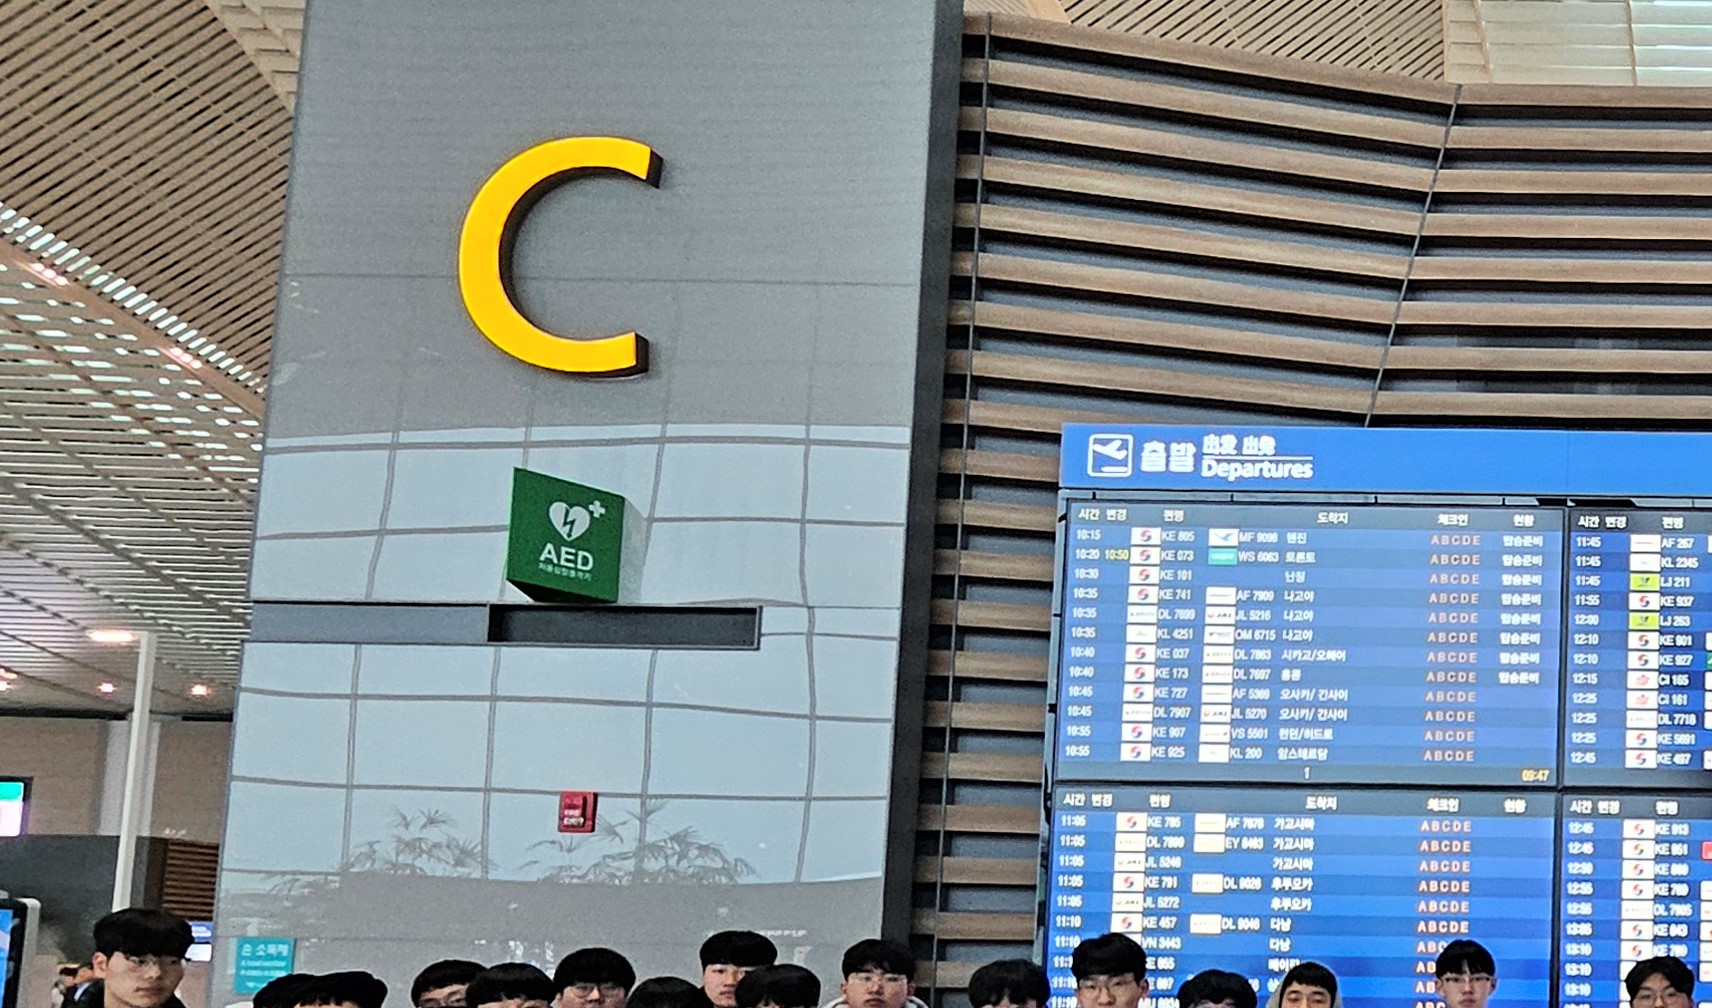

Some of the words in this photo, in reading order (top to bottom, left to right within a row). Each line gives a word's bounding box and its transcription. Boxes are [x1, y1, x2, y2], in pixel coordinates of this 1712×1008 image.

[459, 136, 661, 378] C
[1141, 441, 1196, 473] 출발
[1201, 460, 1313, 481] Departures
[1079, 509, 1099, 521] 시간
[1106, 509, 1127, 521] 변경
[1163, 510, 1184, 522] 편명
[1317, 512, 1348, 524] 도착지
[1437, 514, 1469, 525] 체크인
[1076, 528, 1101, 540] 10:15
[1162, 531, 1176, 542] KE
[1239, 532, 1255, 543] MF
[539, 543, 593, 571] AED
[1075, 548, 1099, 560] 10:20
[1105, 550, 1129, 560] 10:50
[1161, 550, 1175, 561] KE
[1074, 568, 1098, 579] 10:30
[1160, 570, 1174, 581] KE
[1177, 570, 1192, 581] 101
[1674, 577, 1690, 588] 211
[1073, 588, 1098, 599] 10:35
[1159, 589, 1173, 600] KE
[1236, 591, 1251, 602] AF
[1284, 591, 1315, 602] 나고야
[1157, 629, 1170, 640] KL
[1071, 647, 1095, 658] 10:40
[1156, 649, 1171, 659] KE
[1156, 668, 1170, 679] KE
[1172, 668, 1188, 679] 173
[1155, 688, 1169, 699] KE
[1171, 688, 1188, 699] 727
[1153, 727, 1167, 738] KE
[1143, 917, 1157, 928] KE
